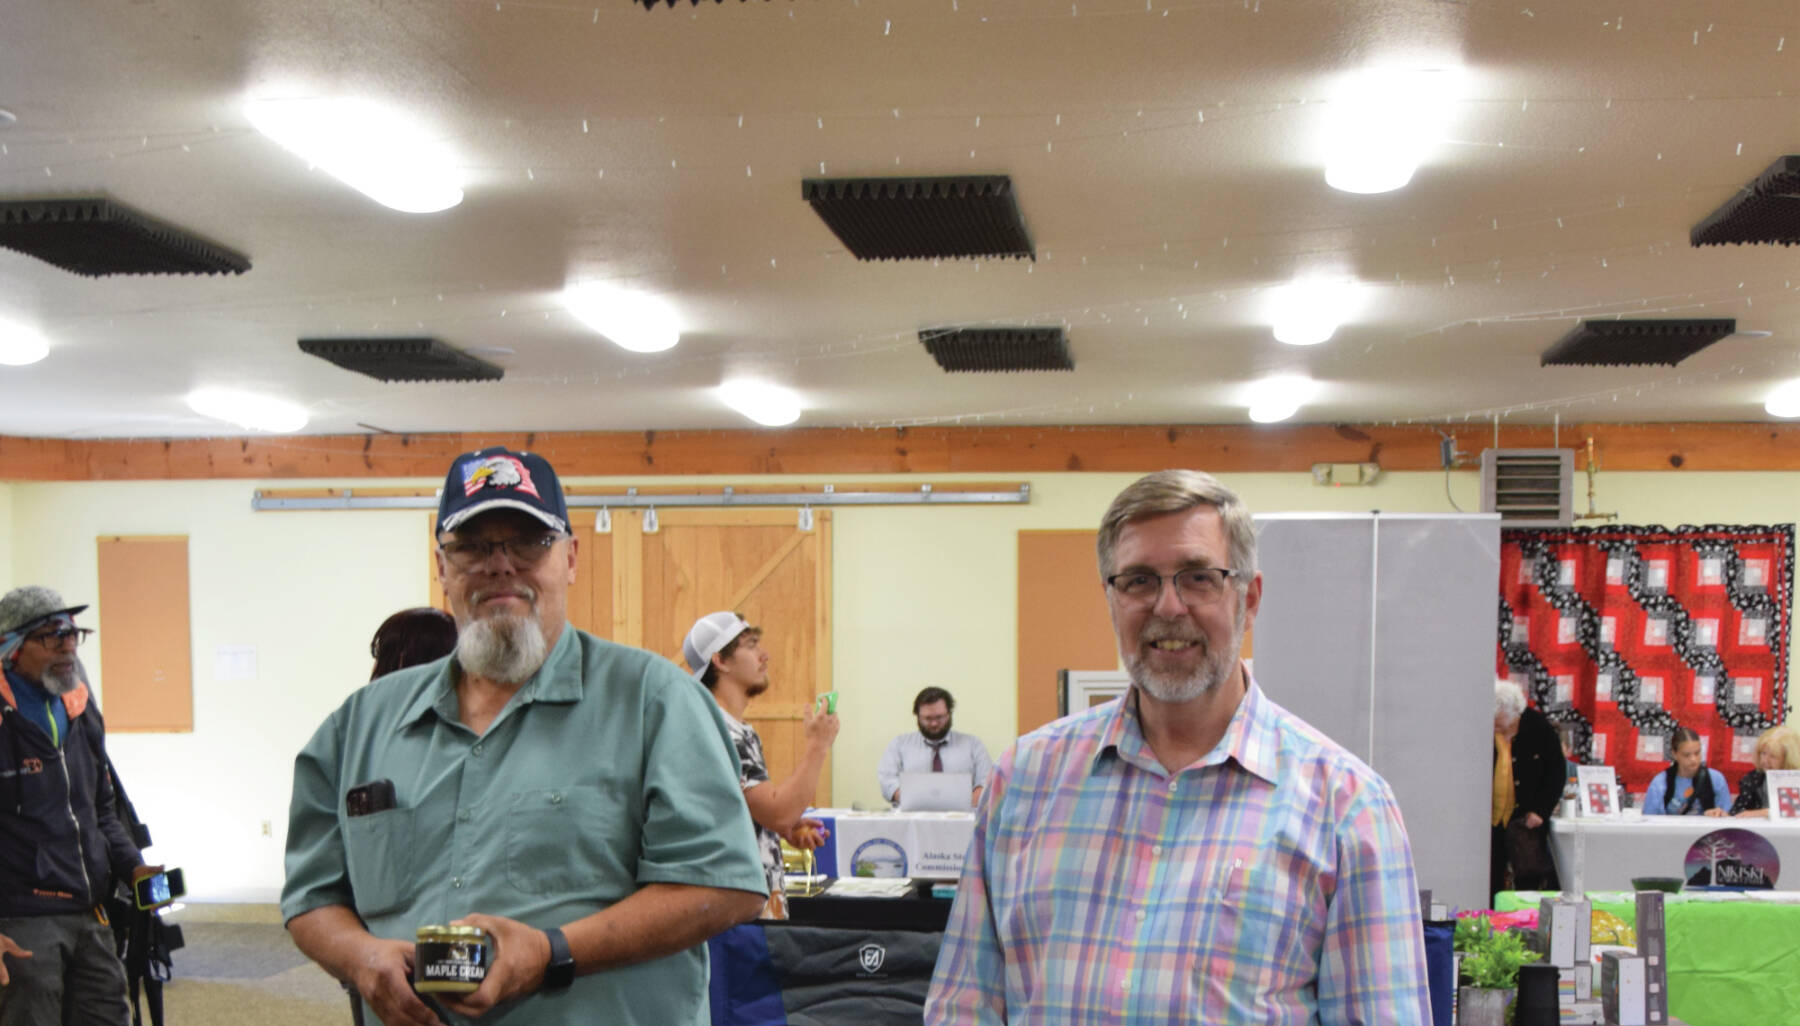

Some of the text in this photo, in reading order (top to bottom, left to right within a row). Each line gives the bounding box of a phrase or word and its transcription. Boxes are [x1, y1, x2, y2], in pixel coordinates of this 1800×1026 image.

[923, 852, 950, 861] Alaska
[1718, 865, 1764, 879] NIKISKI
[425, 964, 457, 977] MAPLE
